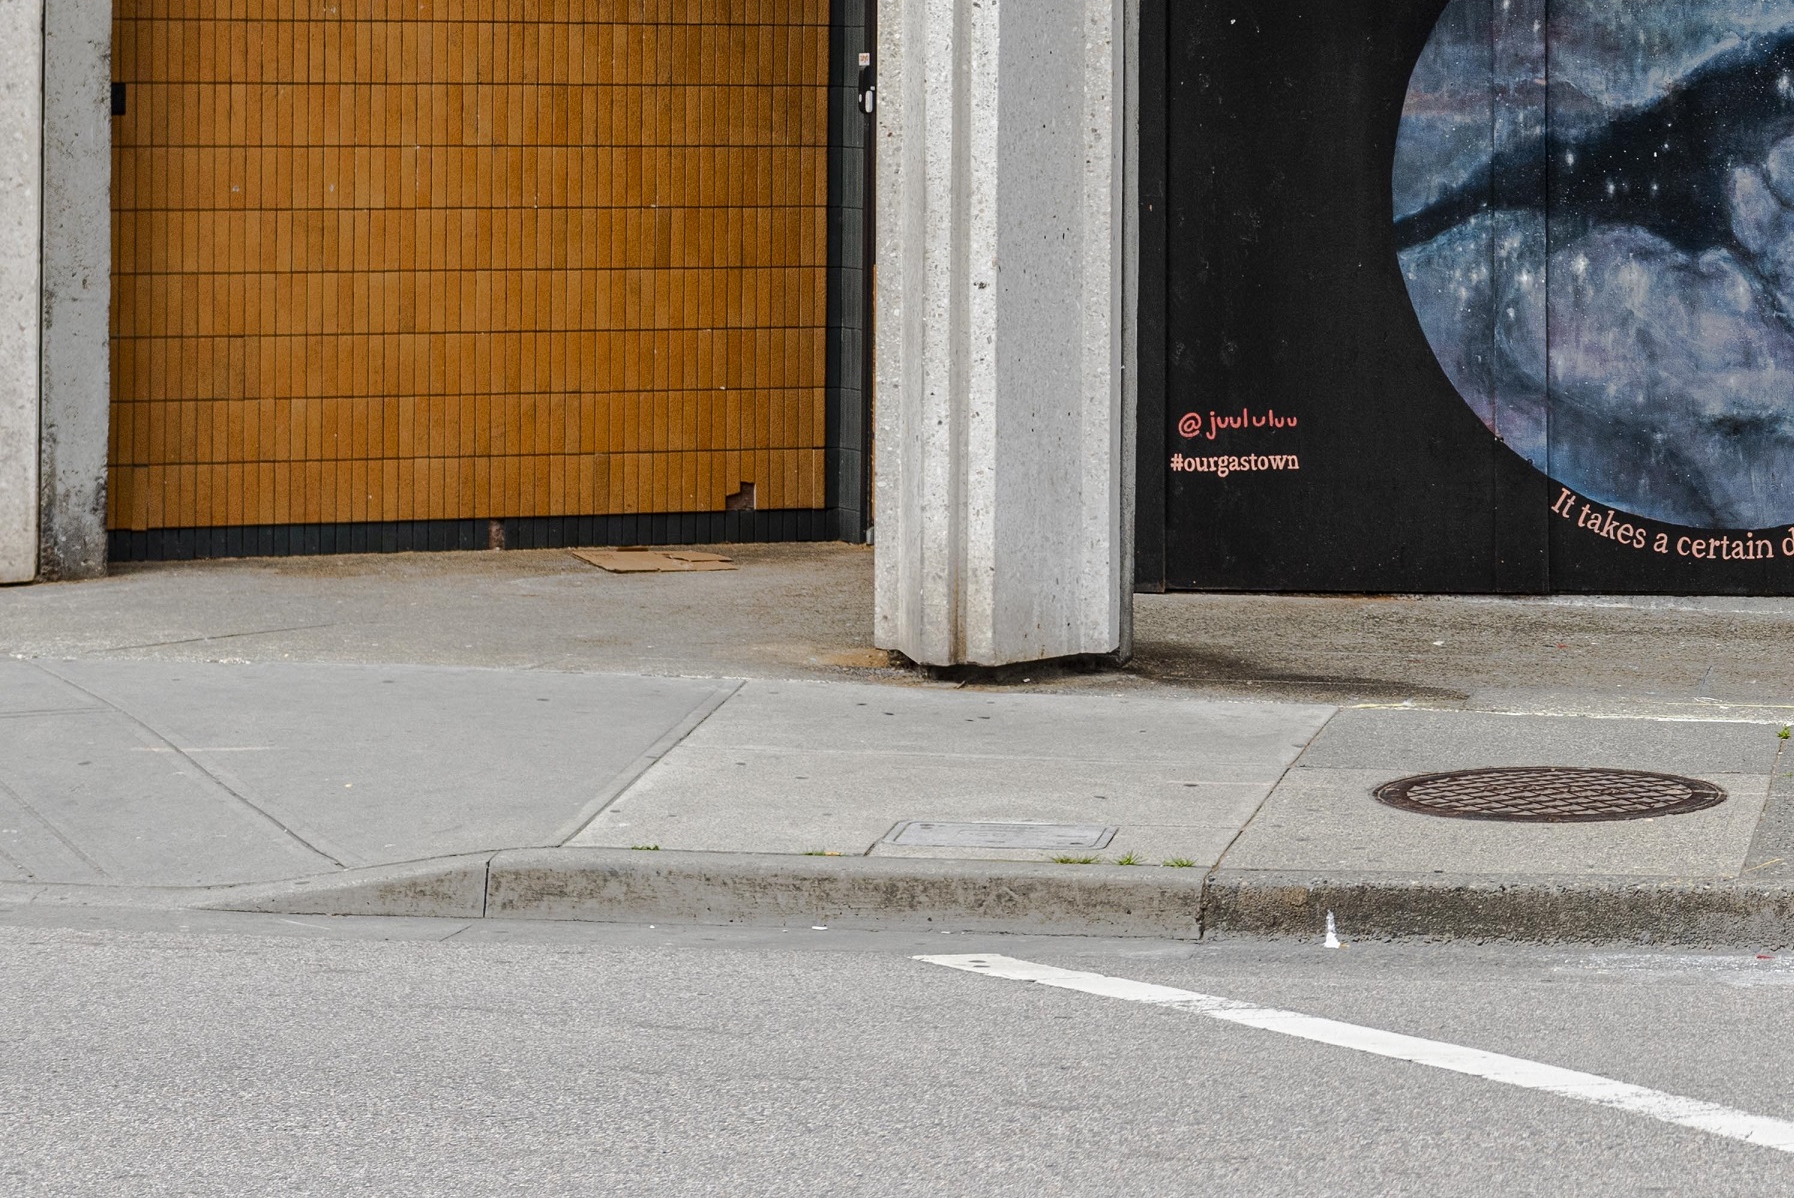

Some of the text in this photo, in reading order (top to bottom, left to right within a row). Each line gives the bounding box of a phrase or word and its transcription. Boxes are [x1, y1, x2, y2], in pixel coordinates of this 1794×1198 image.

[1170, 453, 1299, 477] #ourgastown
[1551, 487, 1574, 516] It
[1577, 503, 1645, 548] takes
[1653, 536, 1667, 552] a
[1677, 532, 1773, 560] certain
